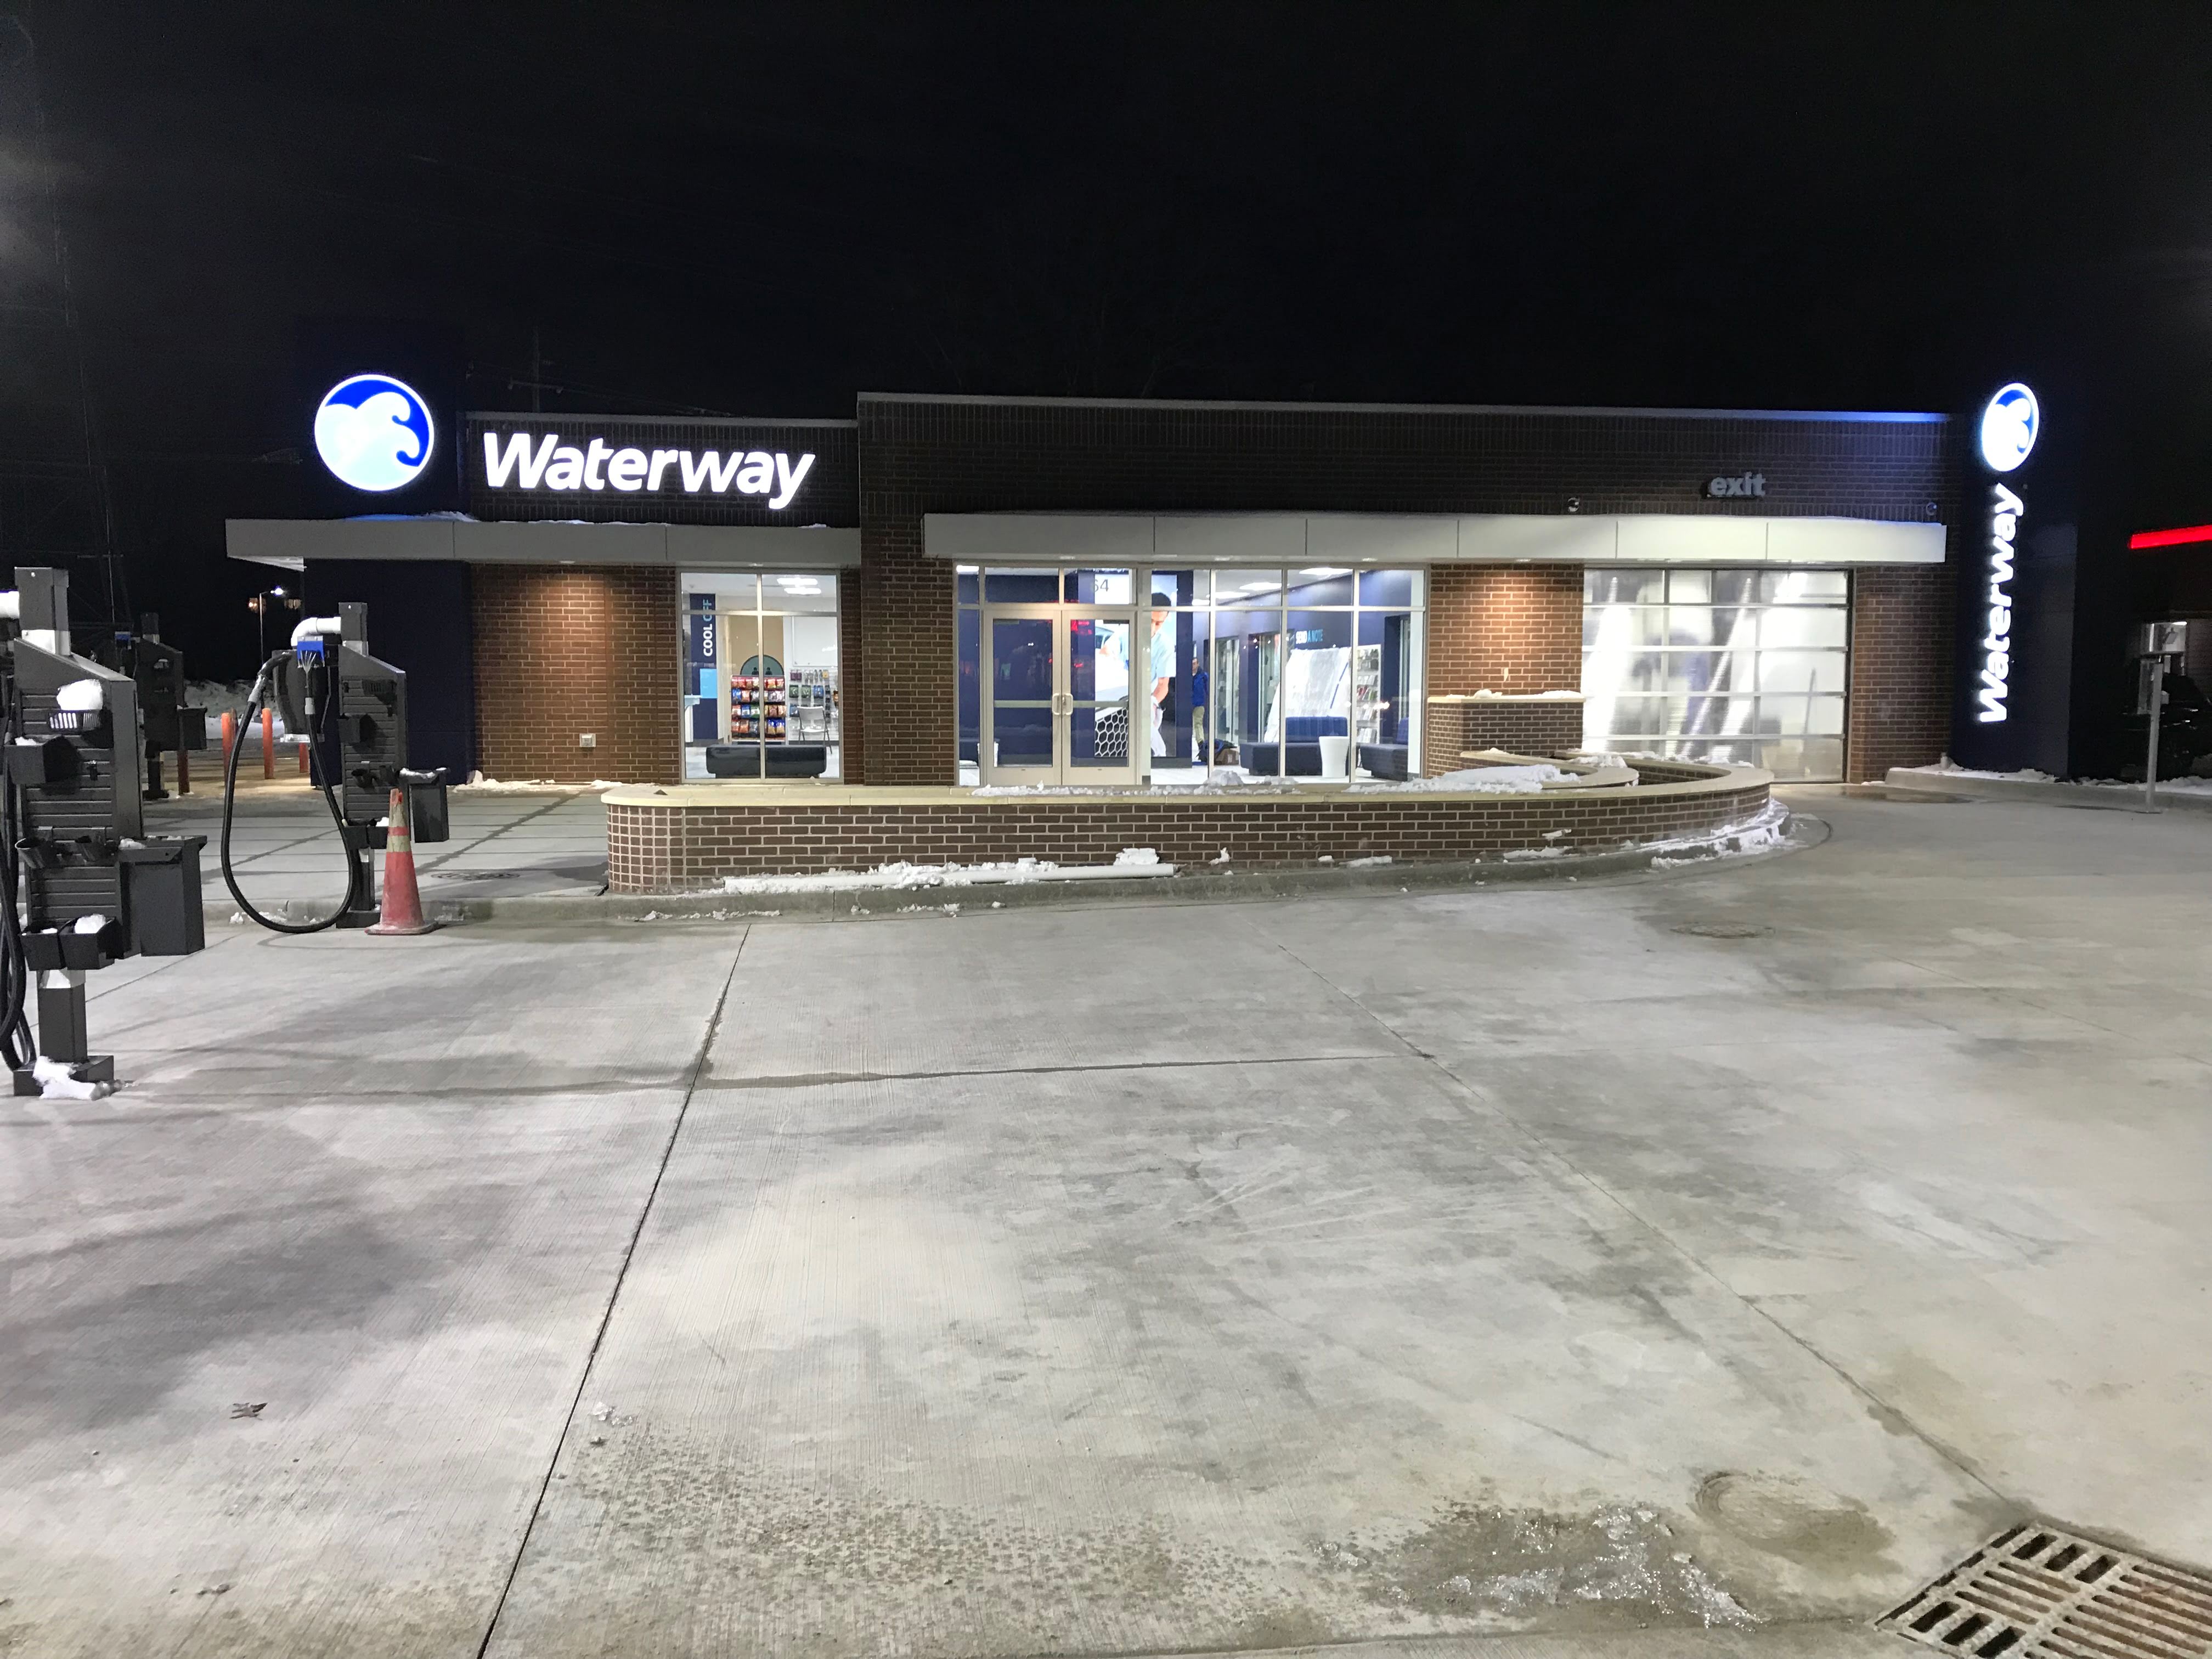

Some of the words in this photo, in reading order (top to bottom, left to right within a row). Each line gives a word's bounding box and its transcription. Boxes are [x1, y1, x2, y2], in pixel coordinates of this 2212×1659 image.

[483, 432, 816, 510] Waterway
[1709, 471, 1766, 496] exit
[1979, 483, 2023, 723] Waterway
[703, 624, 713, 657] COOL
